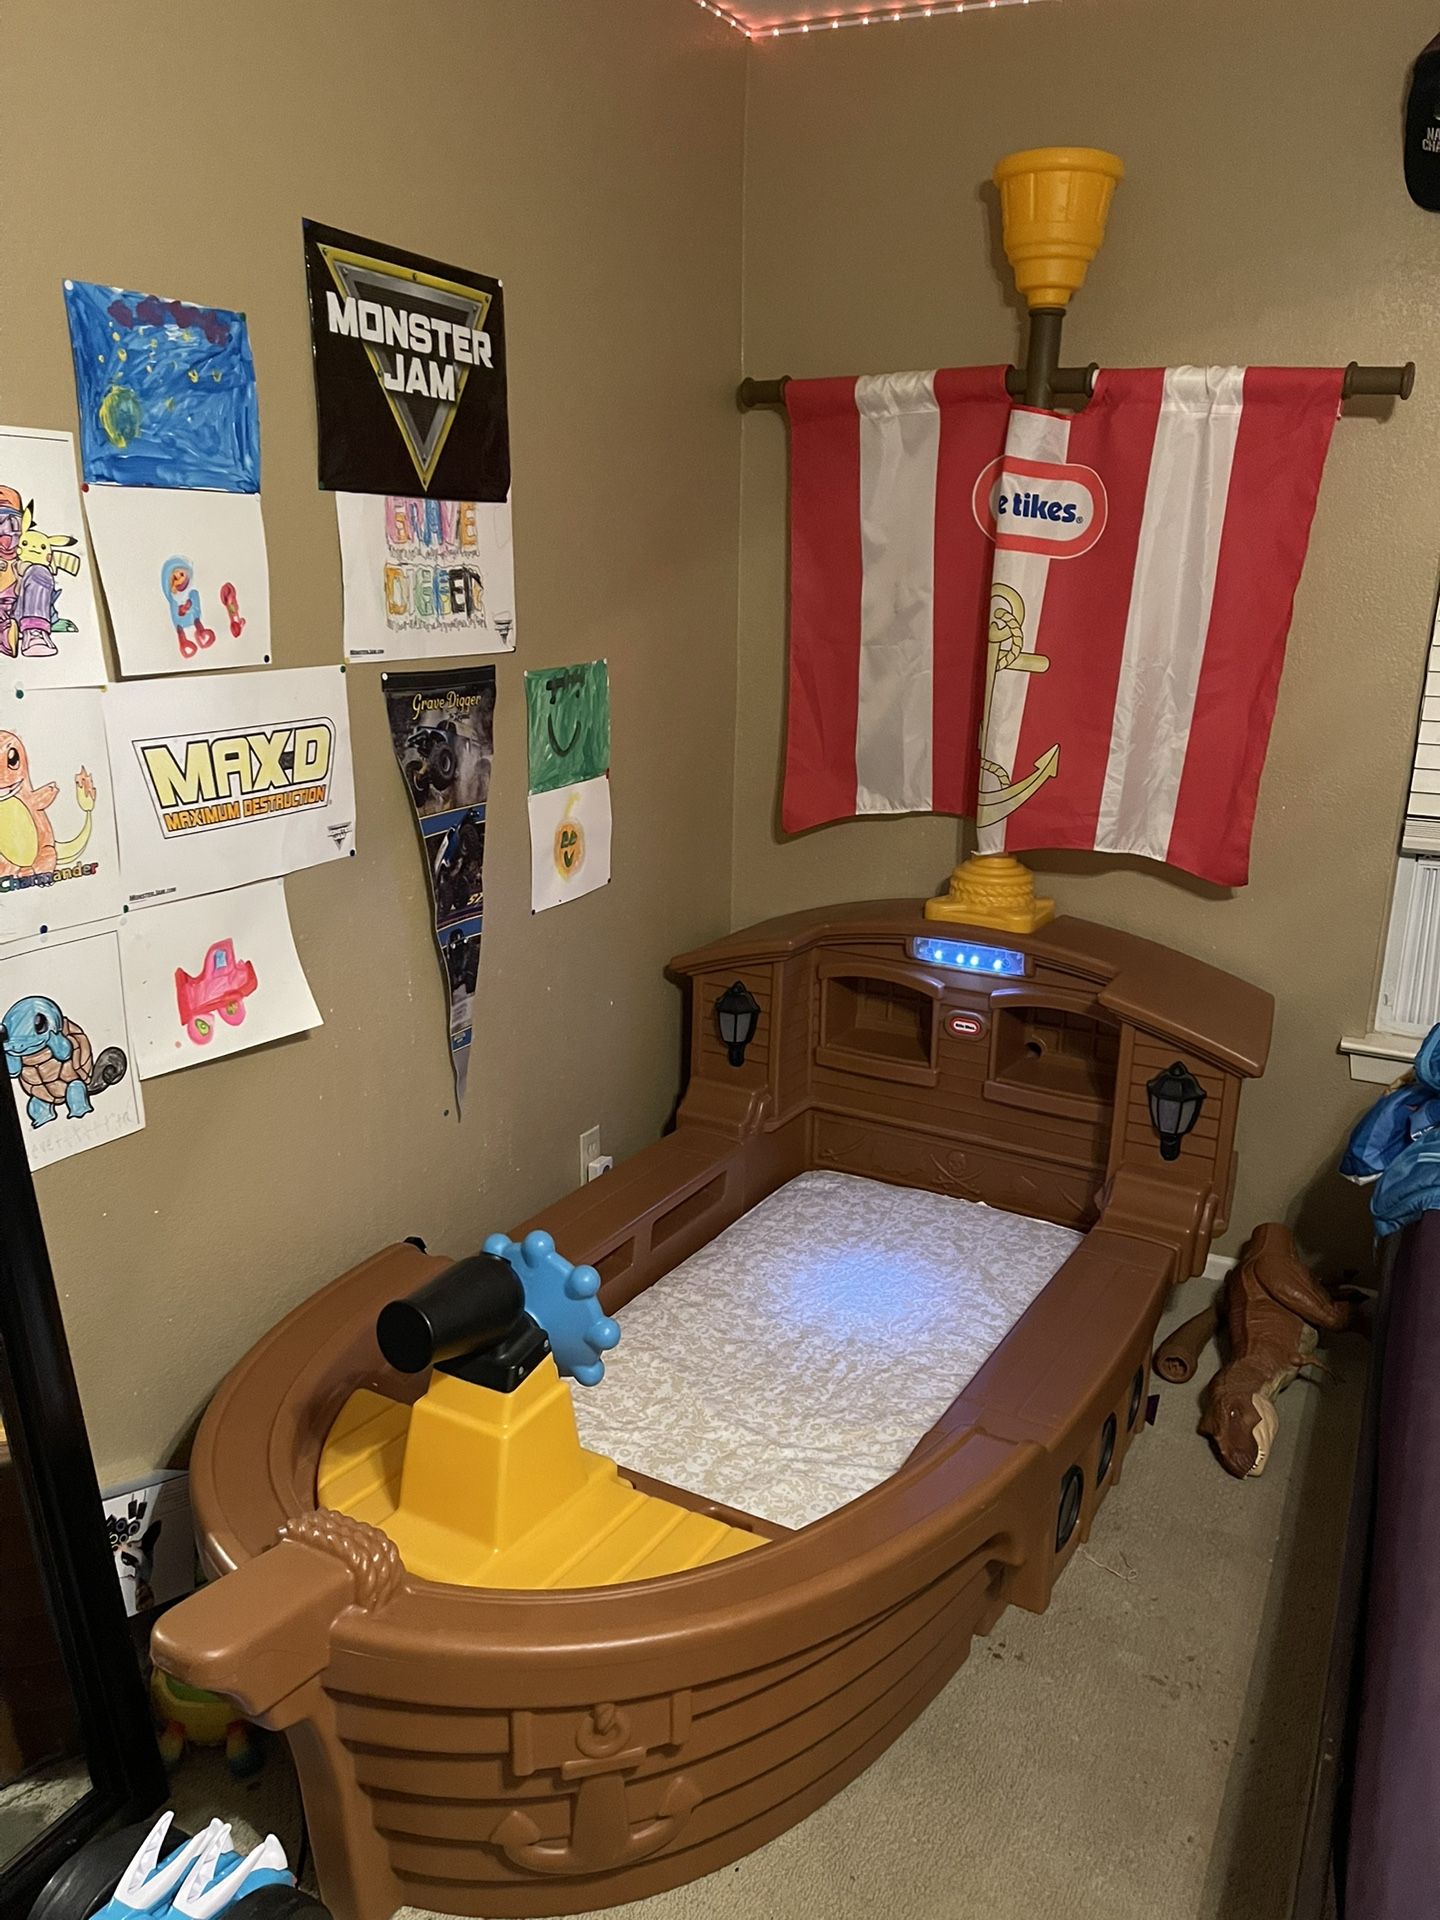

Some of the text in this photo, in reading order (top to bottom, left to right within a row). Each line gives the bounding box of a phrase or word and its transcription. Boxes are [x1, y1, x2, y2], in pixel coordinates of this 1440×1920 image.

[326, 290, 494, 369] MONSTER
[383, 353, 456, 402] JAM
[412, 690, 482, 720] Grave Digger
[162, 784, 327, 832] MAXIMUM DESTRUCTION
